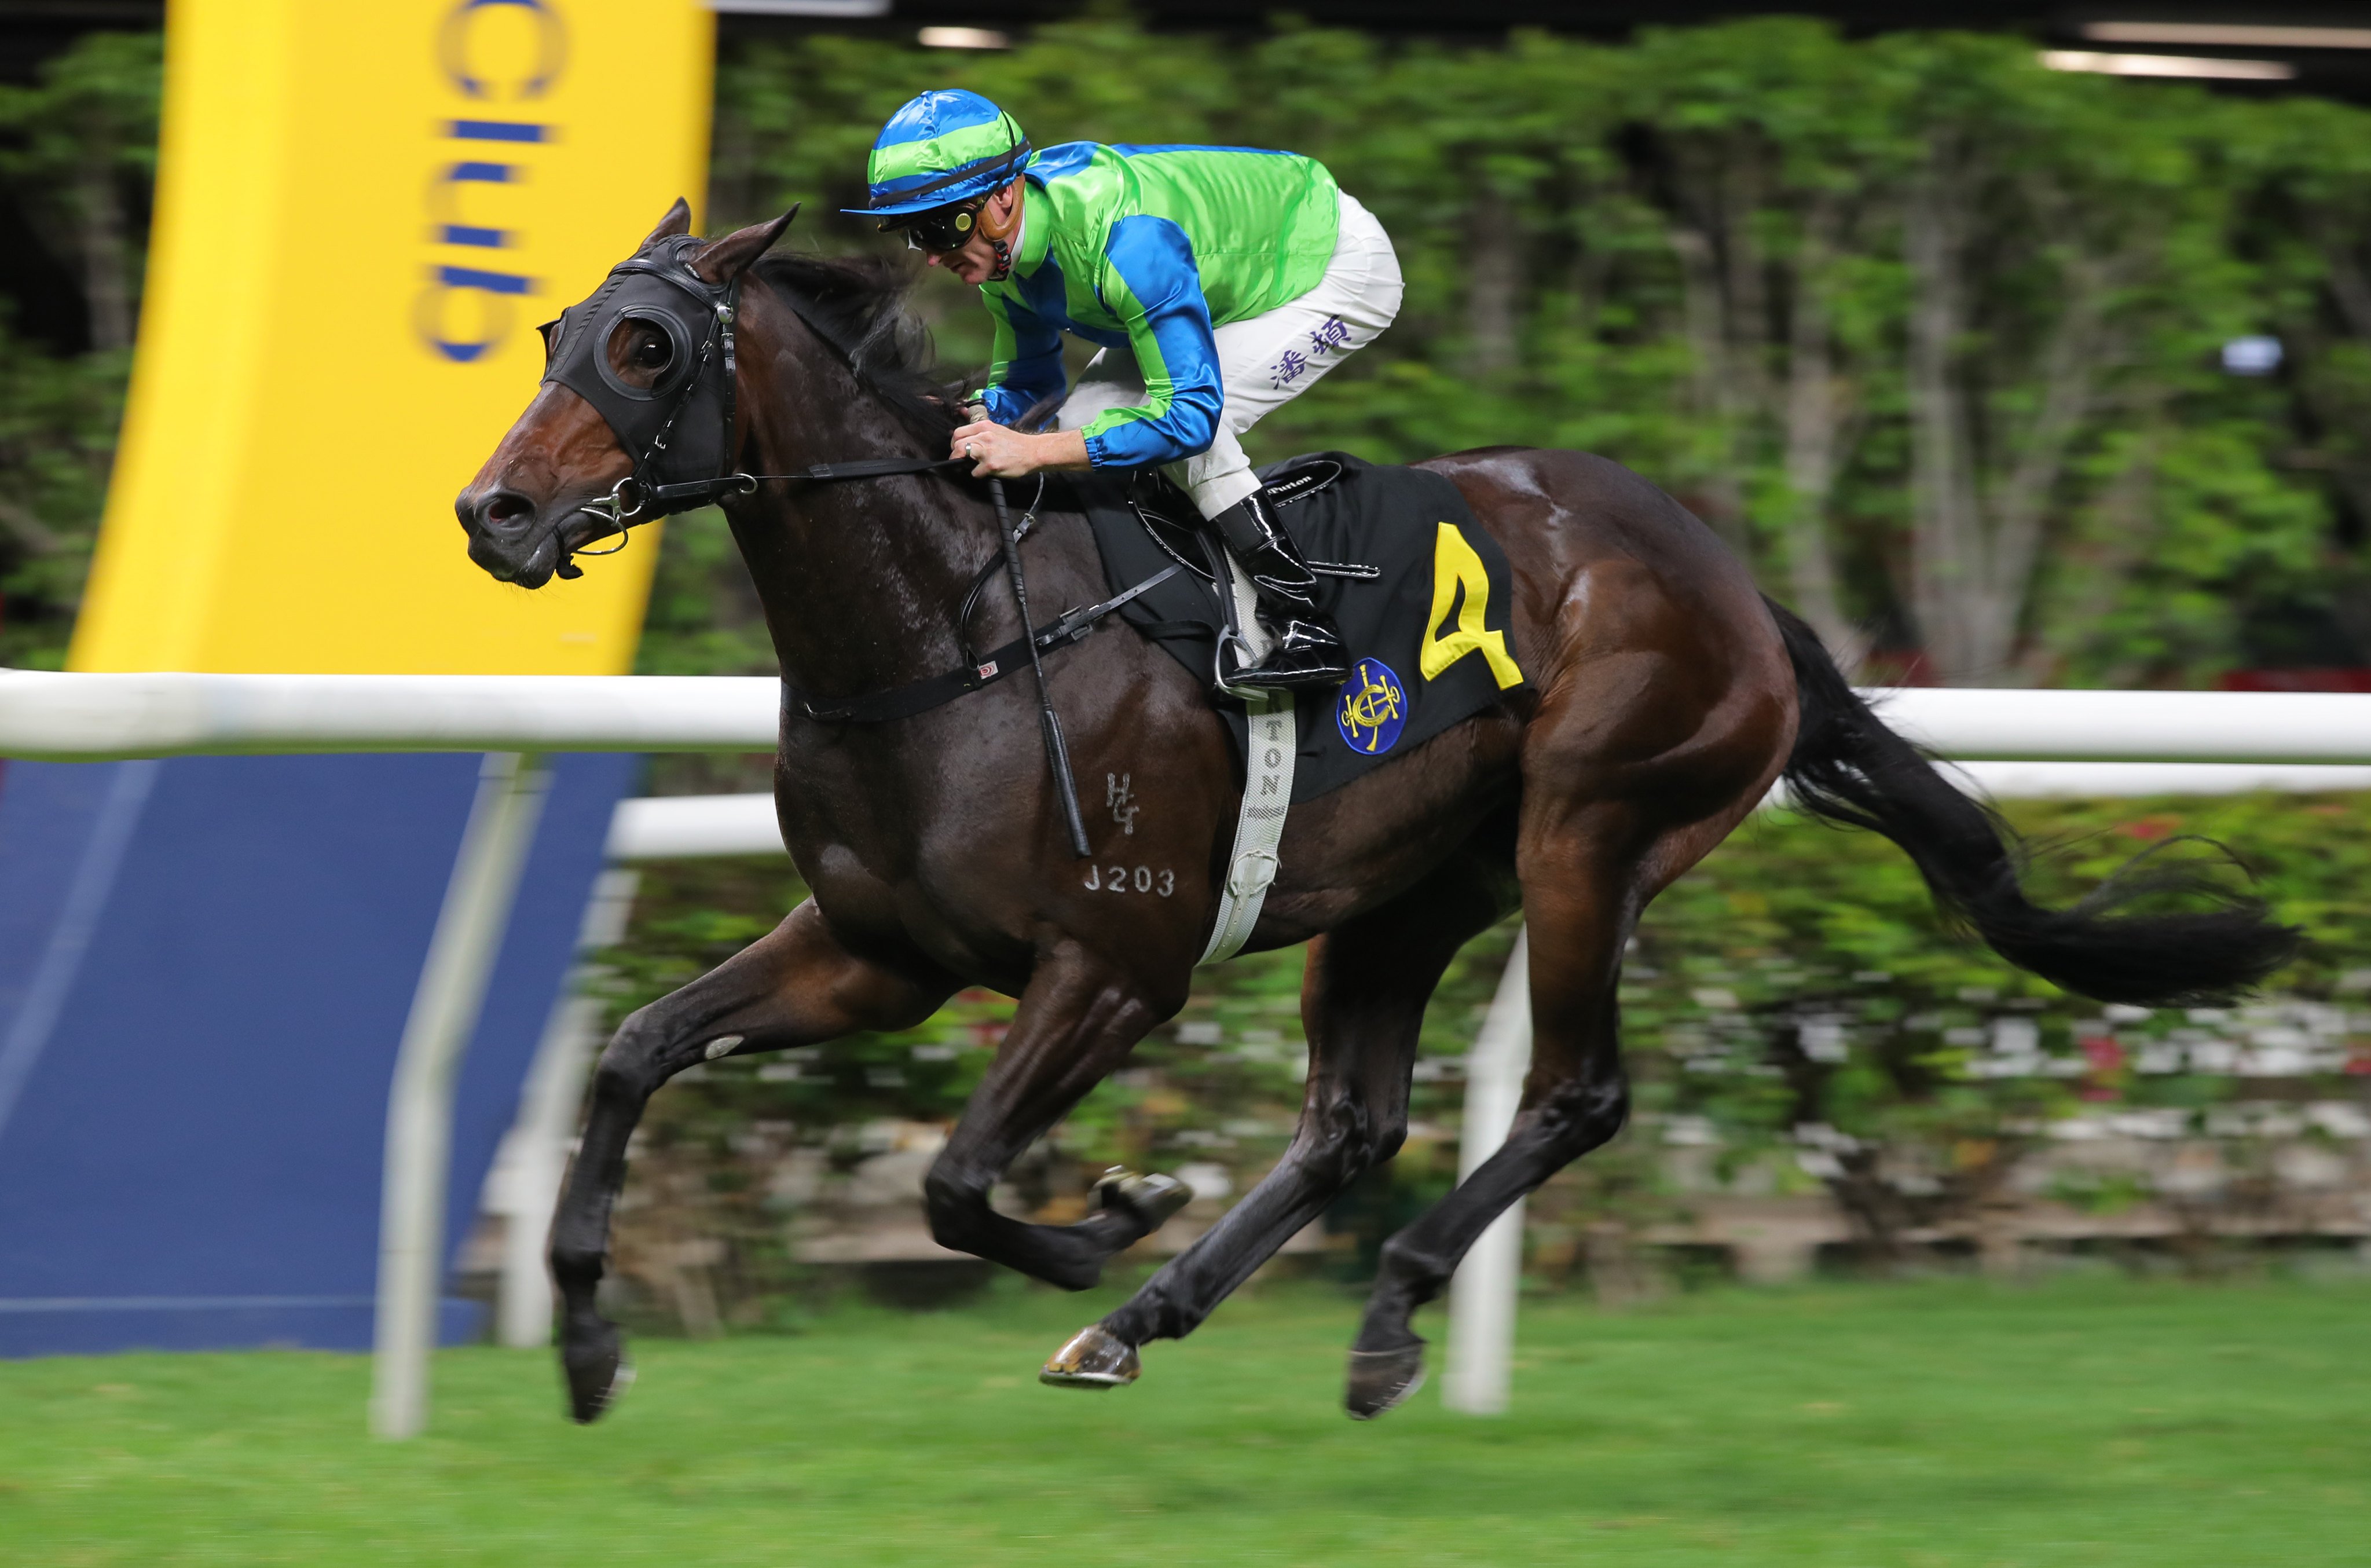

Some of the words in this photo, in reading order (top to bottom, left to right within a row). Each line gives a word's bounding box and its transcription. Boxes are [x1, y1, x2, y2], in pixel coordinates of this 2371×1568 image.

[410, 0, 570, 365] Club
[1270, 314, 1352, 390] 潘頓
[1266, 475, 1313, 496] Purton
[1420, 522, 1524, 690] 4
[1084, 864, 1175, 897] J203
